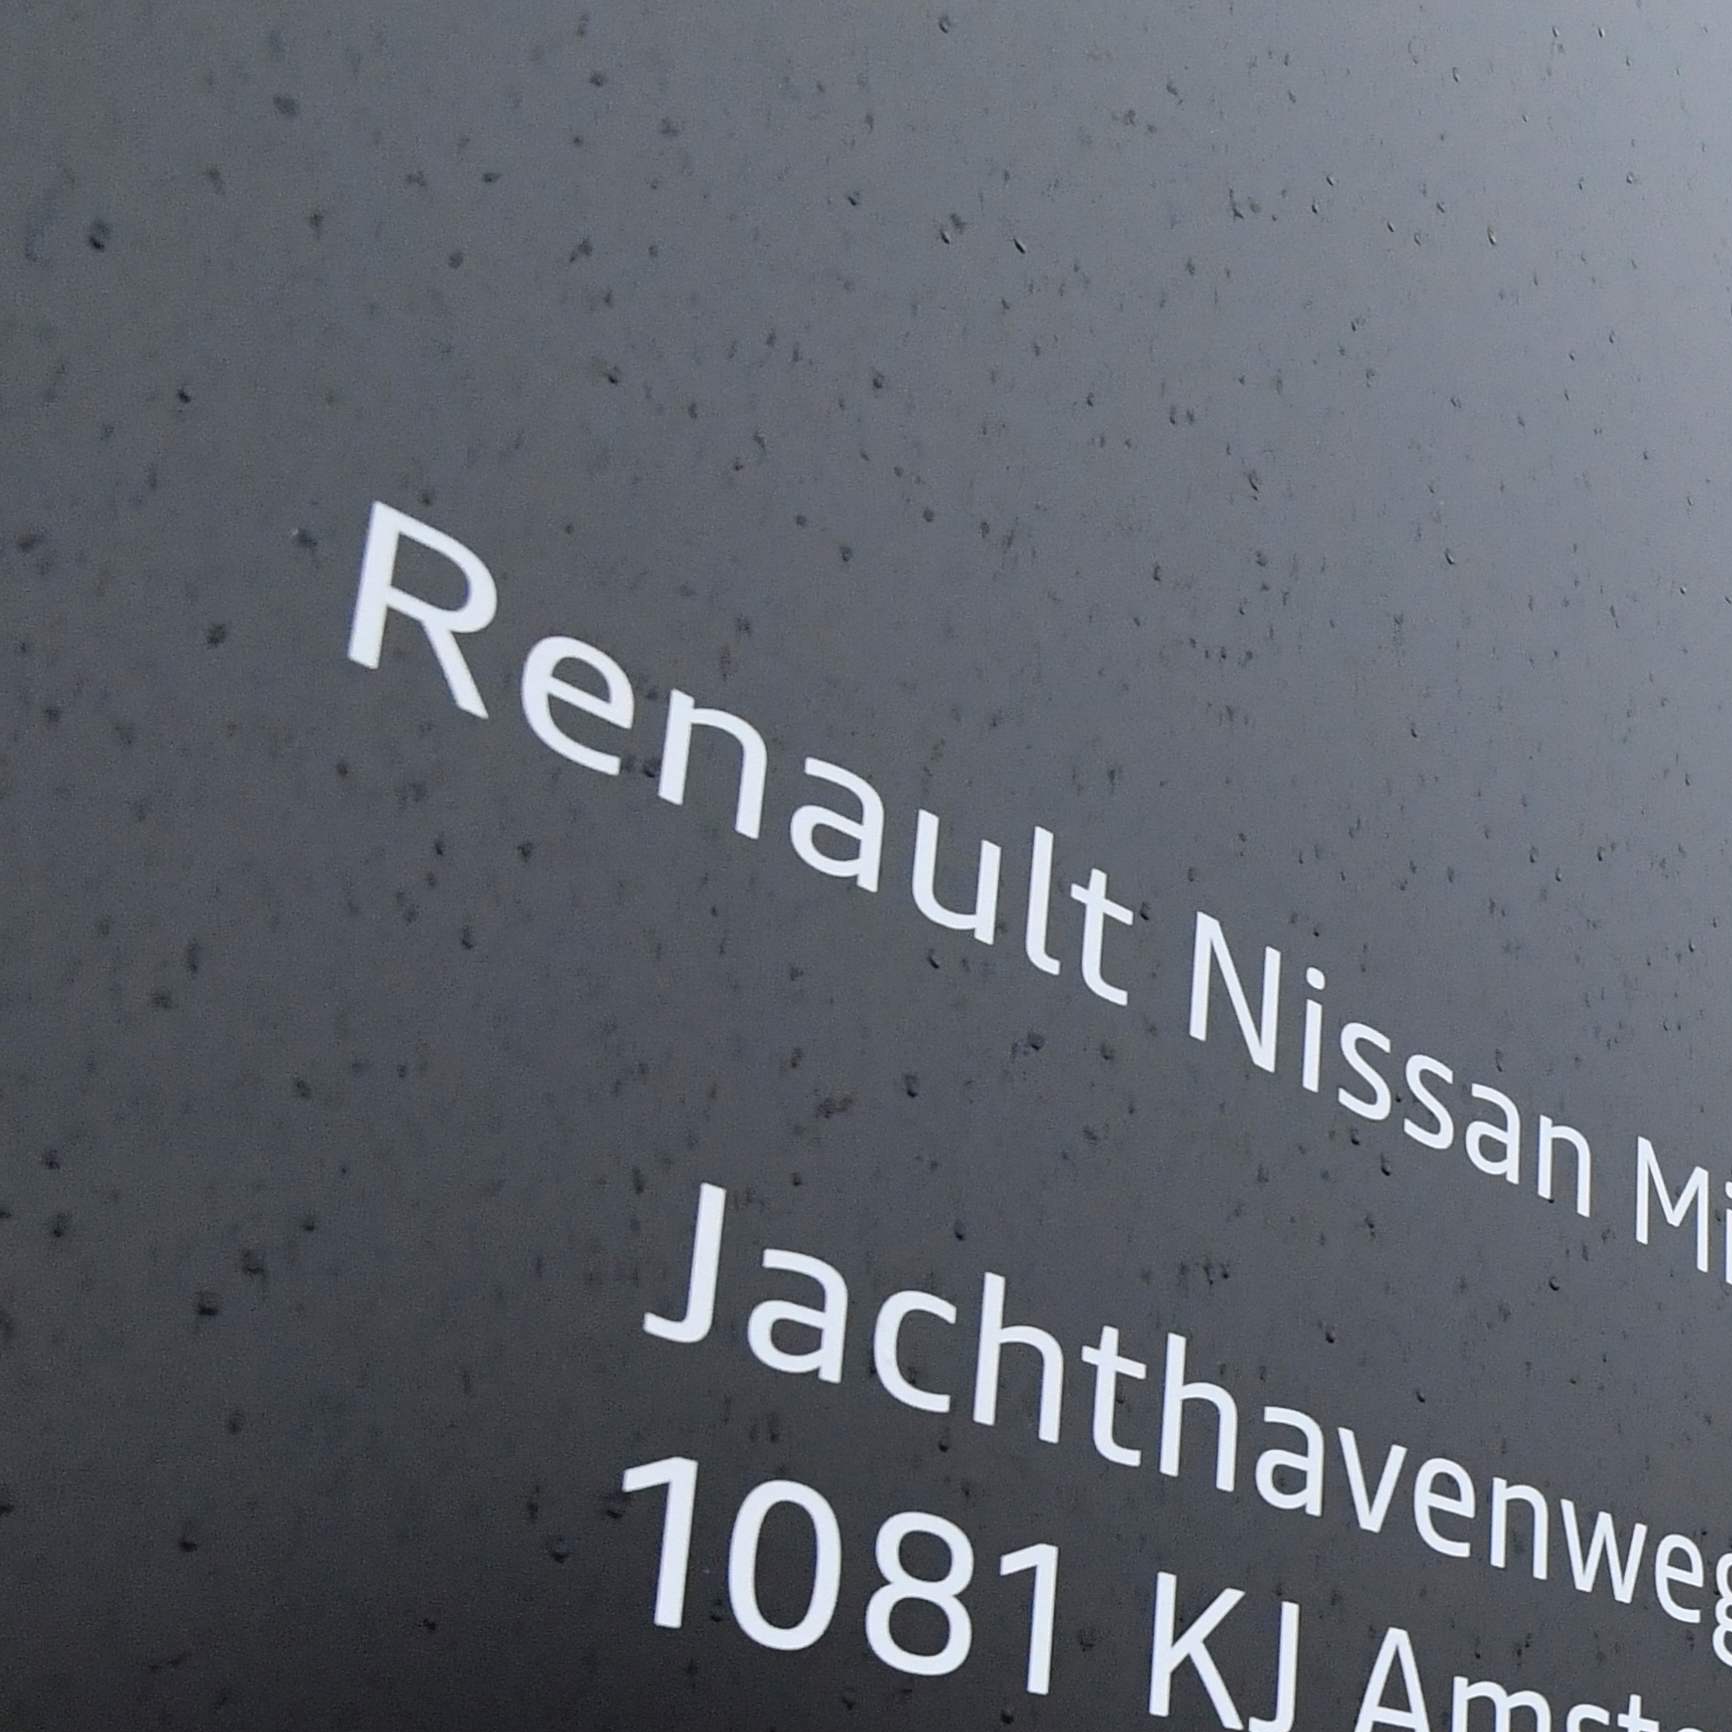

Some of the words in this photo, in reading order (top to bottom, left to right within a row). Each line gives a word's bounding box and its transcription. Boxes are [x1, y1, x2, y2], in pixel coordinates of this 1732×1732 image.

[347, 500, 1135, 1007] Renault
[1188, 910, 1592, 1219] Nissan
[621, 1455, 1060, 1696] 1081
